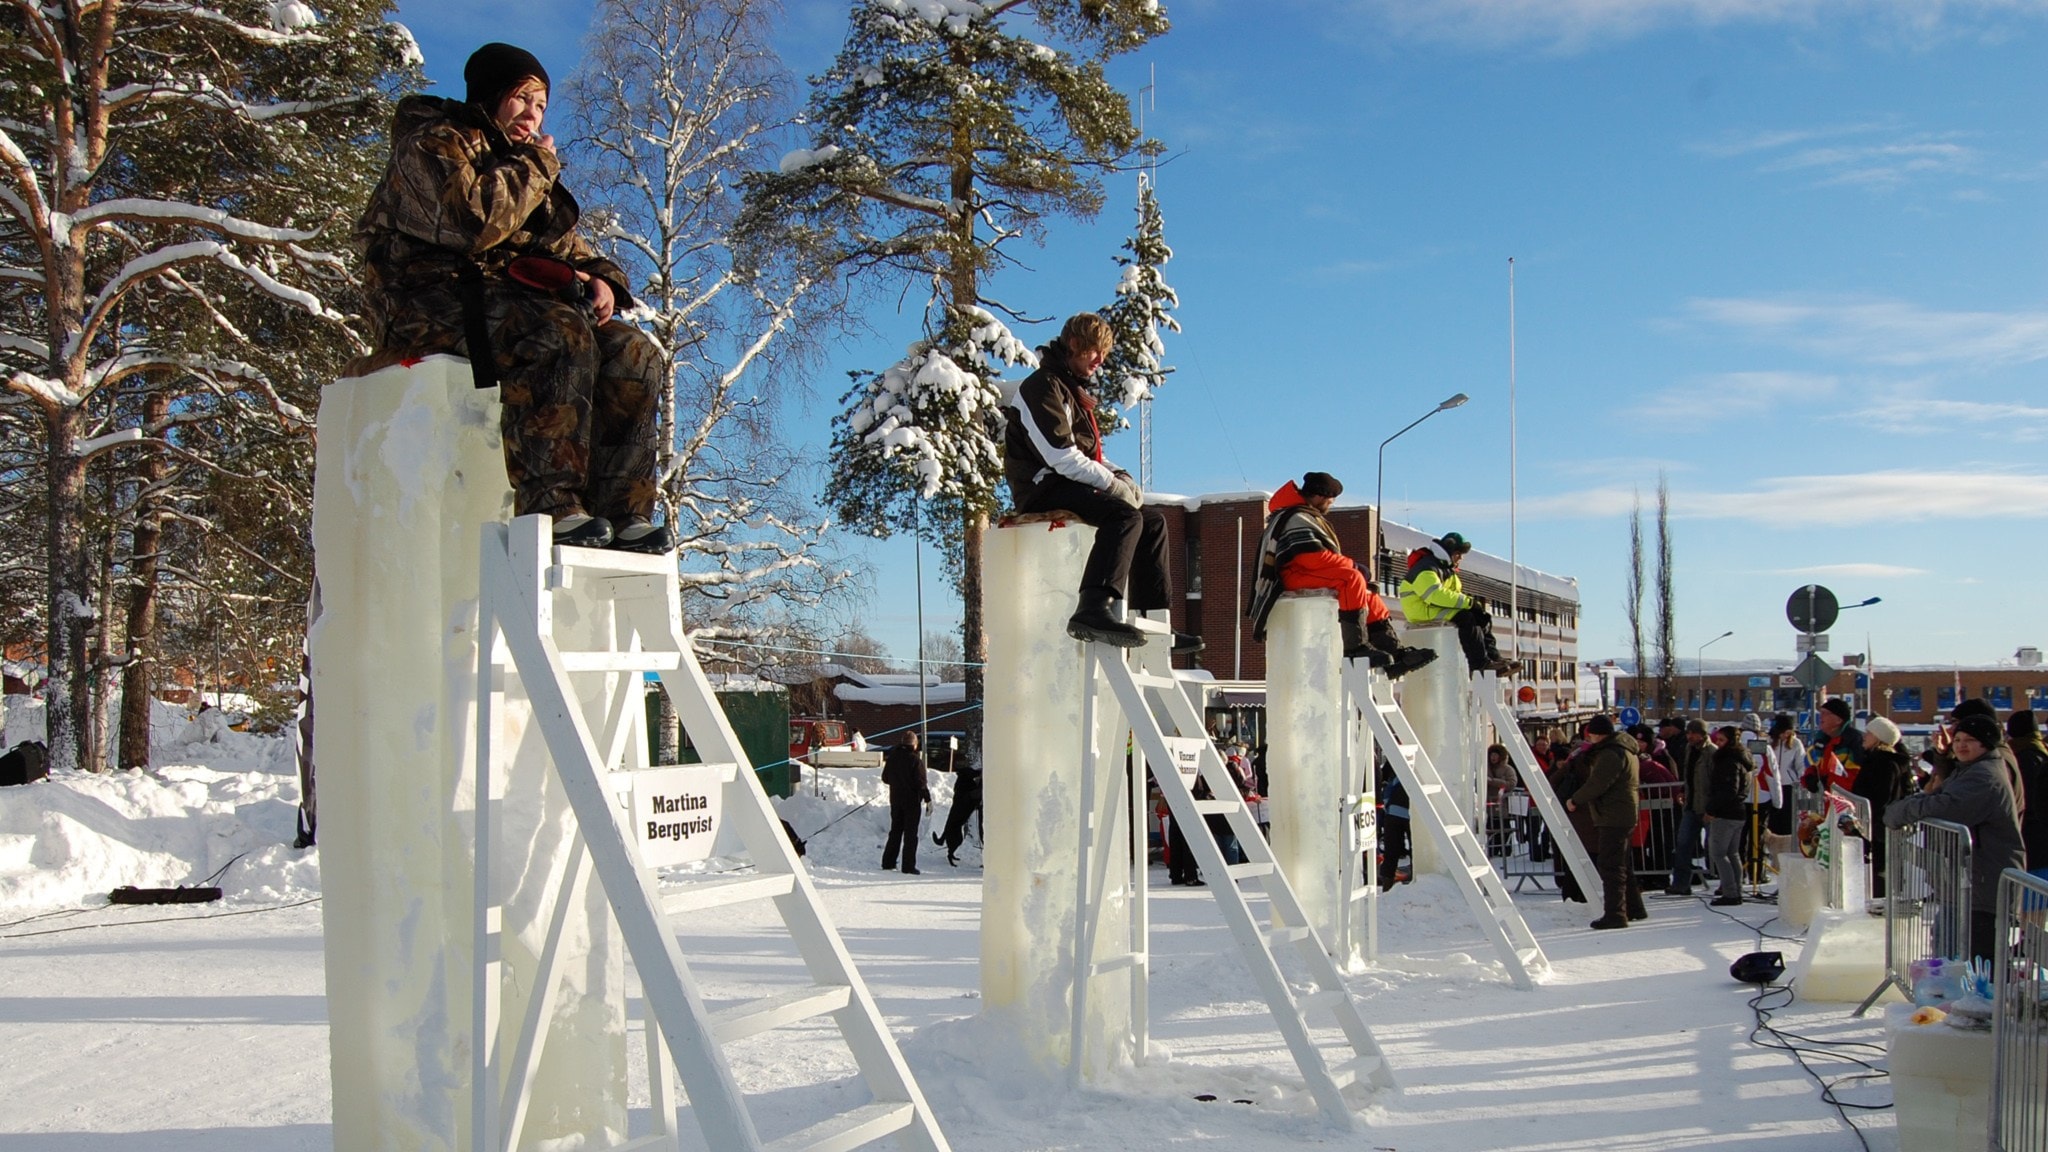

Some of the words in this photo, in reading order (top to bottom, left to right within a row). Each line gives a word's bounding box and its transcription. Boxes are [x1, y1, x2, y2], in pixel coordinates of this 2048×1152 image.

[652, 793, 707, 814] Martina
[647, 816, 713, 841] Bergqvist
[1354, 810, 1375, 831] NEOS
